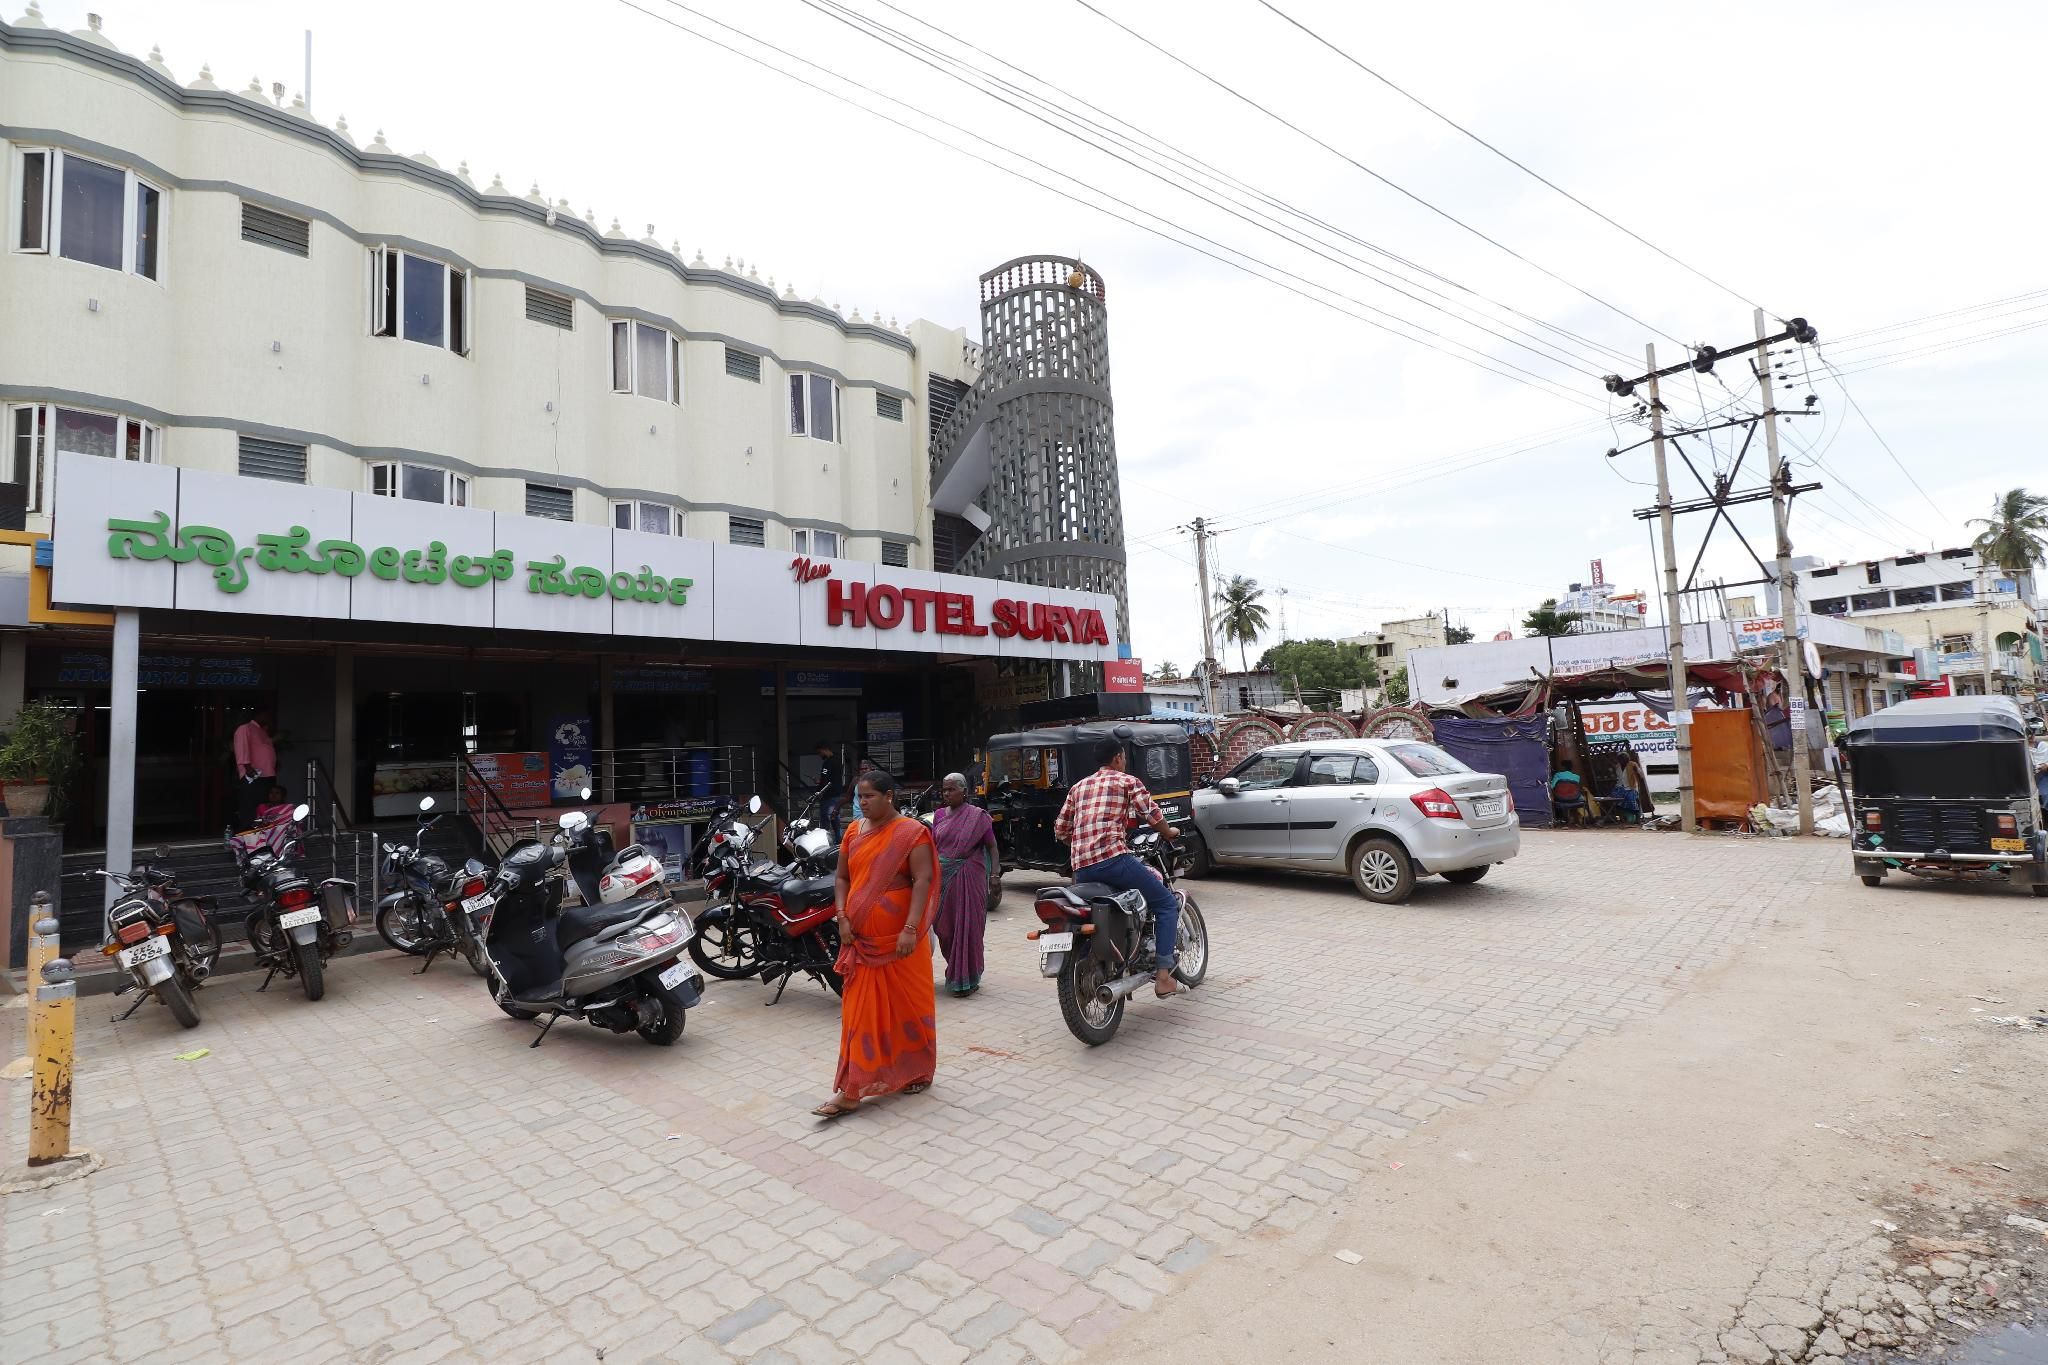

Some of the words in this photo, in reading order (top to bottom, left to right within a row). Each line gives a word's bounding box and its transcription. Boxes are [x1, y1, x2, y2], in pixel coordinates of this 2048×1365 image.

[788, 556, 831, 583] New
[1592, 562, 1601, 585] LODG
[827, 579, 988, 636] HOTEL
[992, 599, 1109, 645] SURYA
[138, 670, 191, 685] URYA
[130, 946, 164, 965] 8094
